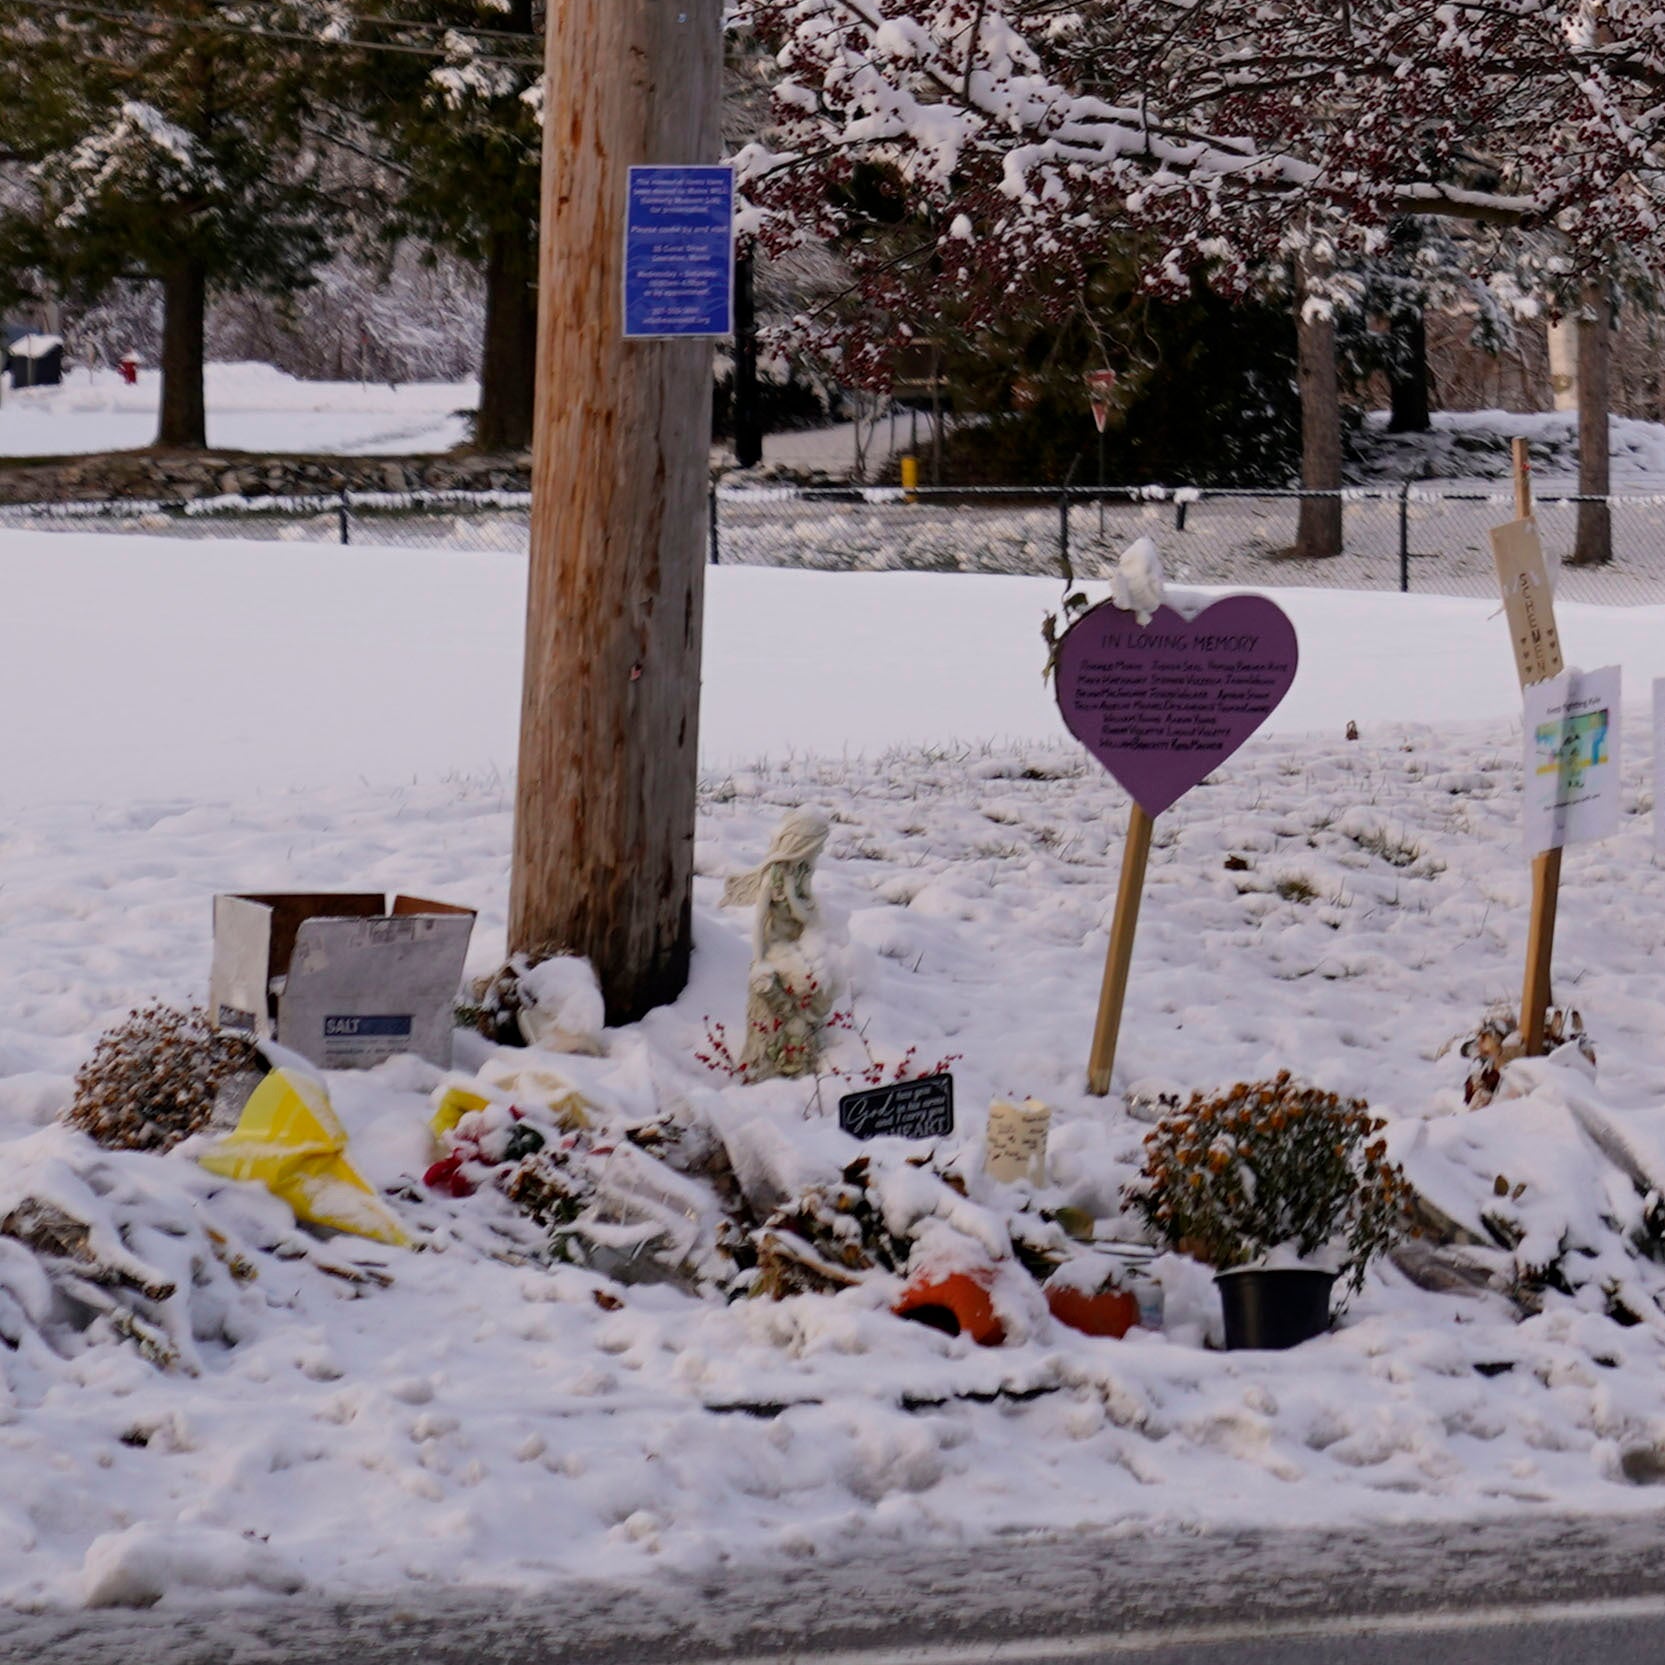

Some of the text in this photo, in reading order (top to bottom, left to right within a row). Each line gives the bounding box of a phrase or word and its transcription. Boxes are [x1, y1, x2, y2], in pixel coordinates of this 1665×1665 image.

[1102, 633, 1258, 653] IN LOVING MEMORY
[325, 1017, 360, 1034] SALT
[846, 1090, 895, 1133] God
